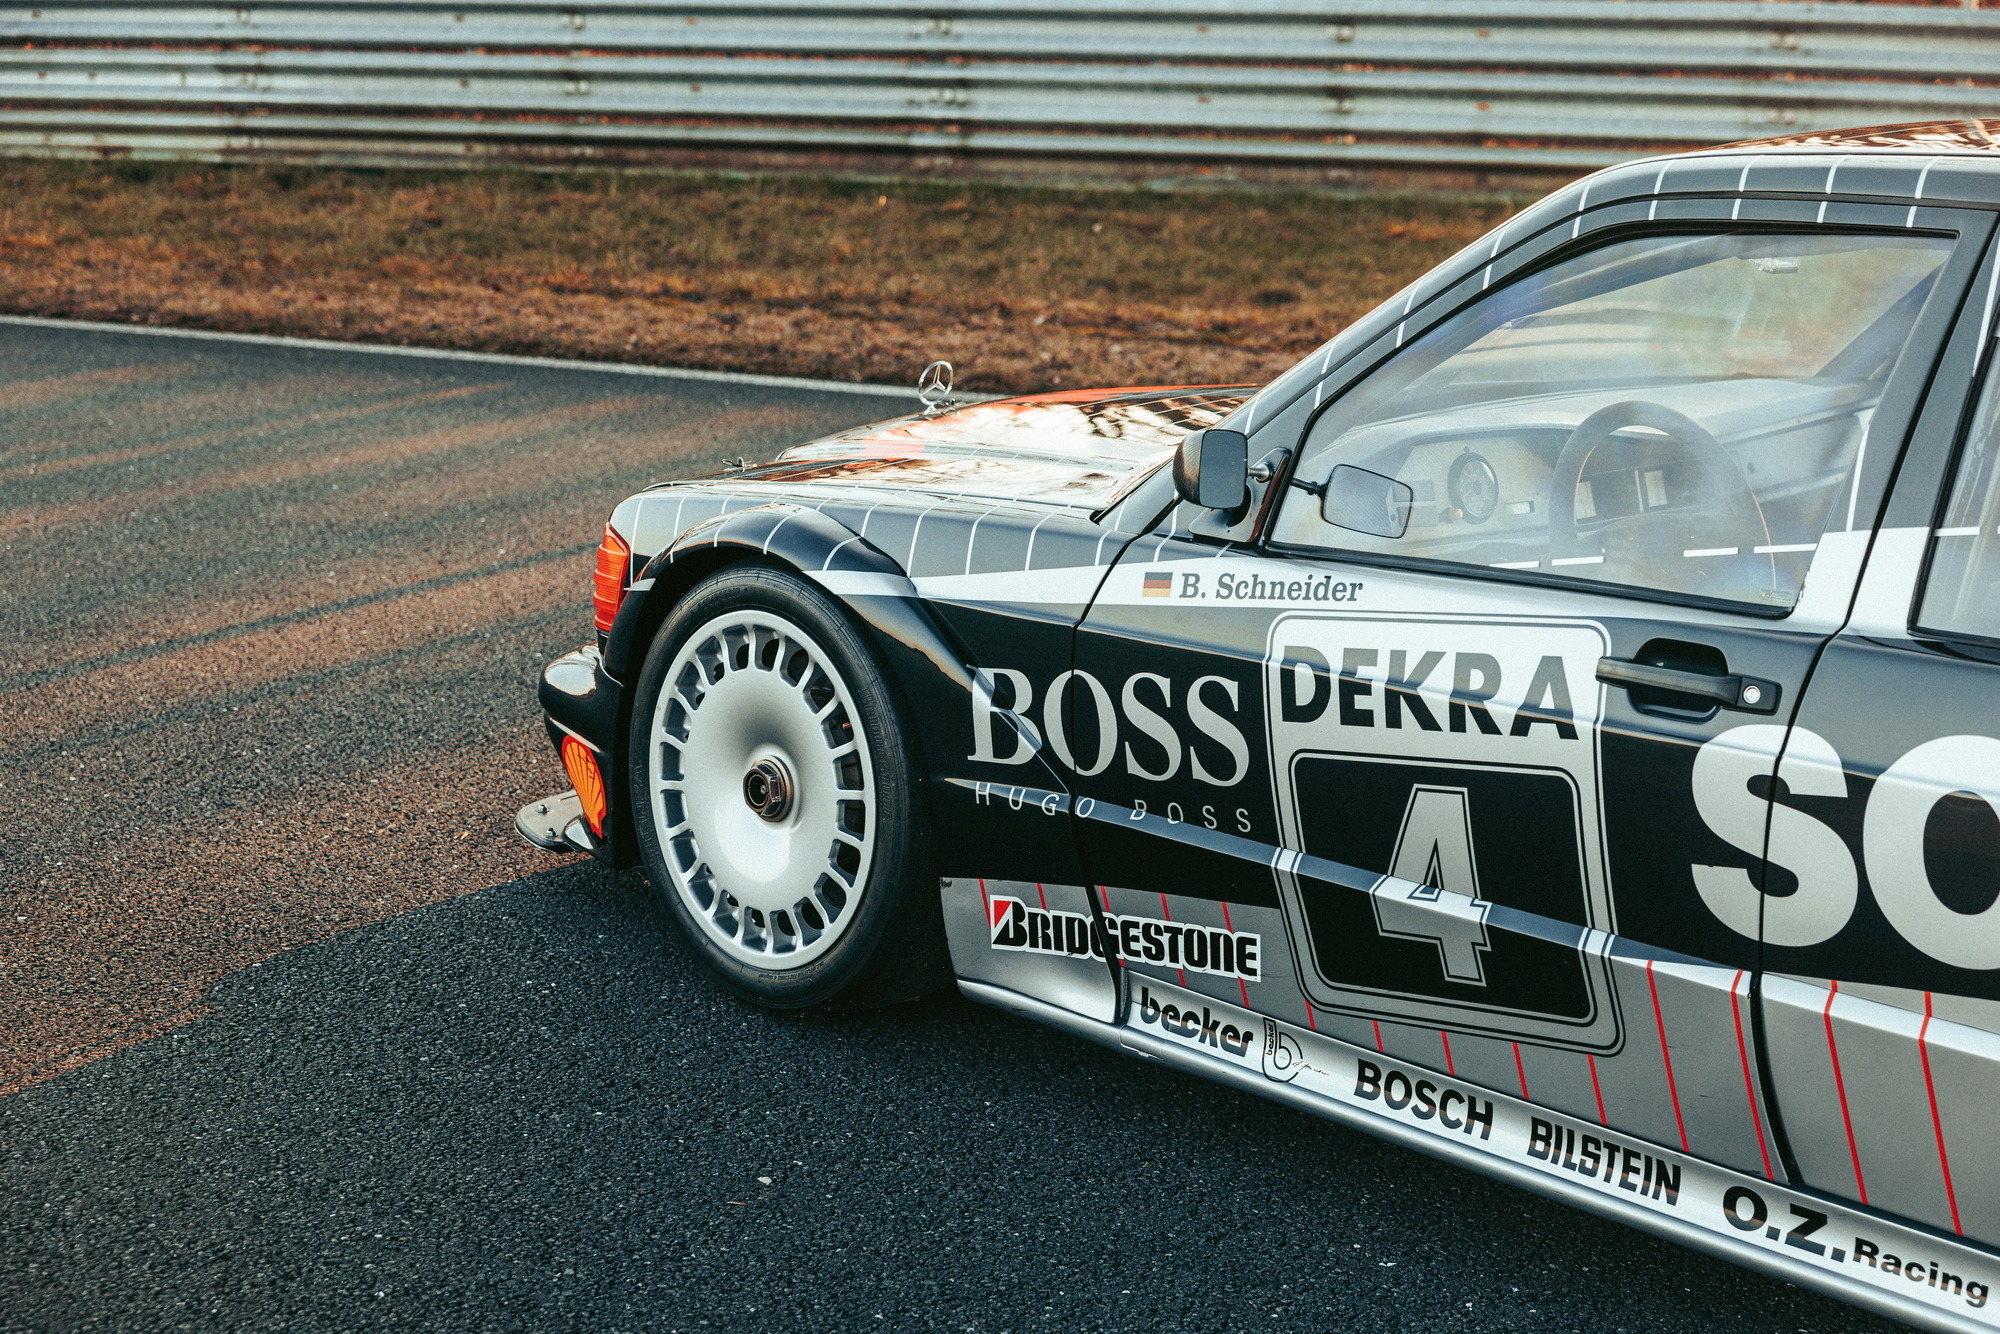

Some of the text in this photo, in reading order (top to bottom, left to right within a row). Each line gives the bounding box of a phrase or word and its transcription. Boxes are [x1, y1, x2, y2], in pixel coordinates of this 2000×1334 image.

[1179, 573, 1363, 602] B. Schneider
[966, 665, 1250, 787] BOSS
[1280, 645, 1580, 741] DEKRA
[975, 782, 1251, 832] HUGO BOSS
[1370, 784, 1492, 987] 4
[991, 896, 1260, 980] BRIDGESTONE
[1140, 986, 1254, 1058] becker
[1266, 1023, 1274, 1056] becker
[1353, 1058, 1494, 1142] BOSCH
[1526, 1116, 1681, 1207] BILSTEIN
